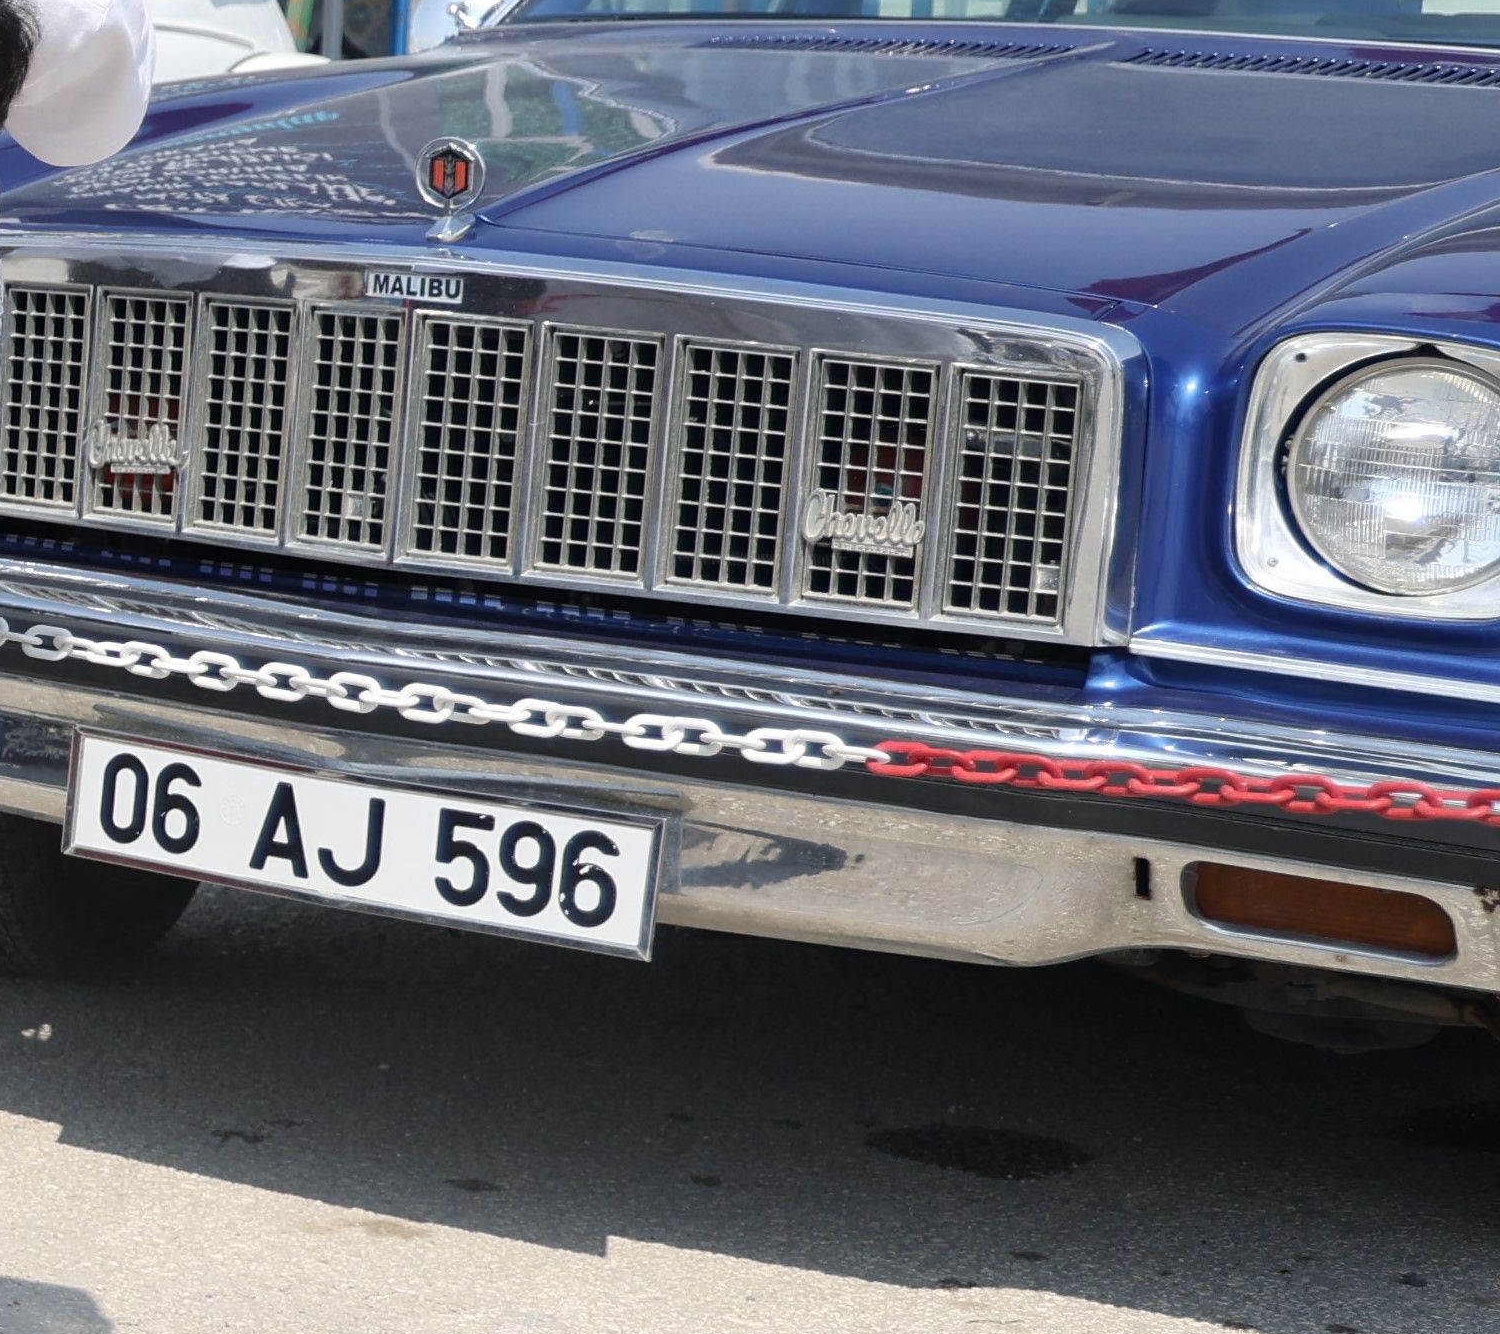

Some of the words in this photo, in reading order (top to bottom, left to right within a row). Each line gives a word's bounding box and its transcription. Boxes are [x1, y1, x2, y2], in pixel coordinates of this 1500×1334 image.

[373, 274, 461, 298] MALIBU
[802, 488, 925, 545] Chevelle
[98, 751, 204, 855] 06
[248, 781, 388, 890] AJ
[433, 809, 622, 930] 596
